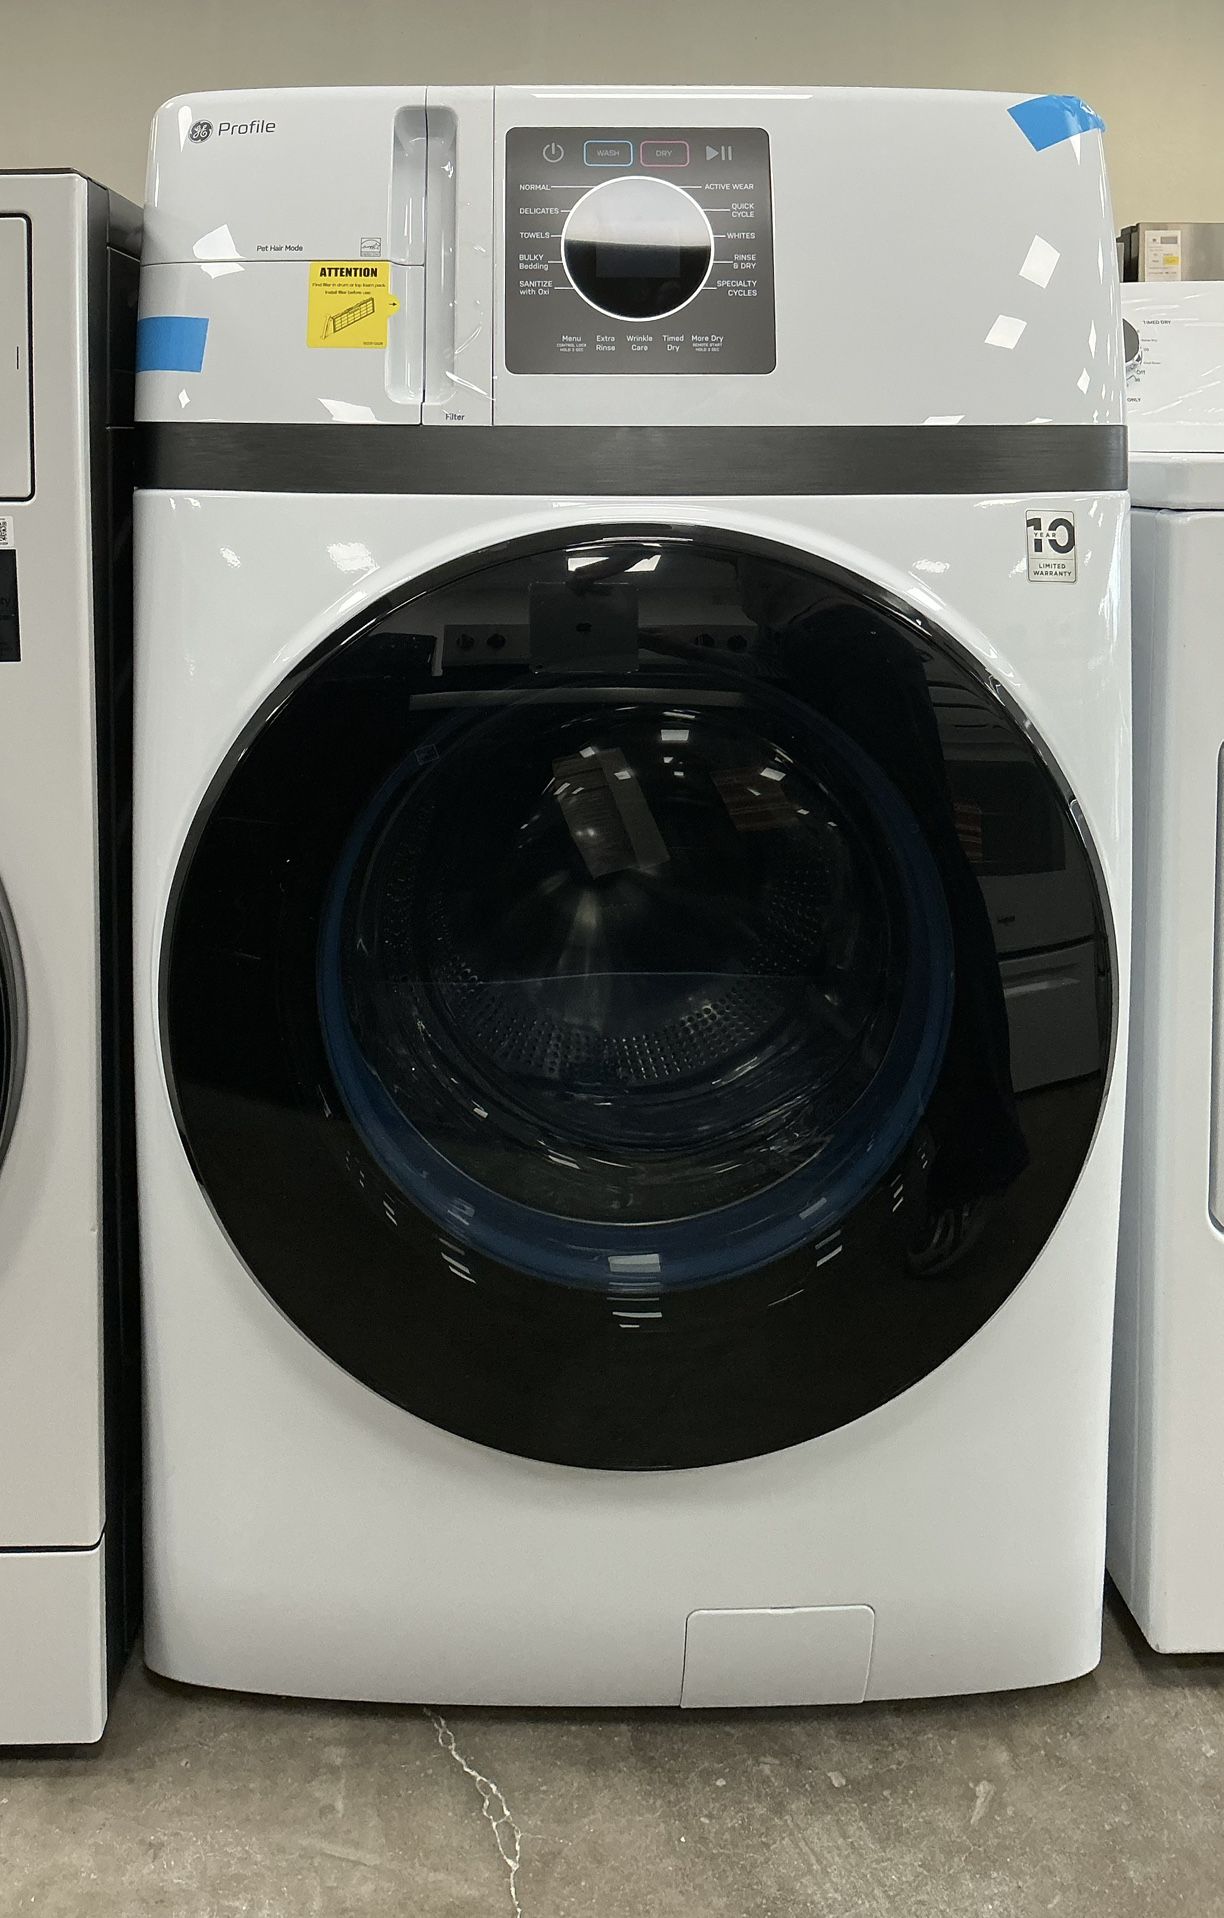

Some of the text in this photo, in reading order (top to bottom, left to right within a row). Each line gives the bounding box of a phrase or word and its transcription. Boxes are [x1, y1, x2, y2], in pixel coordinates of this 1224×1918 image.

[218, 120, 276, 136] Profile
[285, 244, 304, 252] Mode
[519, 262, 549, 271] Bedding
[319, 267, 378, 278] ATTENTION
[716, 280, 757, 288] SPECIALTY
[711, 335, 724, 343] Dry
[667, 344, 680, 352] Dry
[1026, 518, 1075, 554] 10
